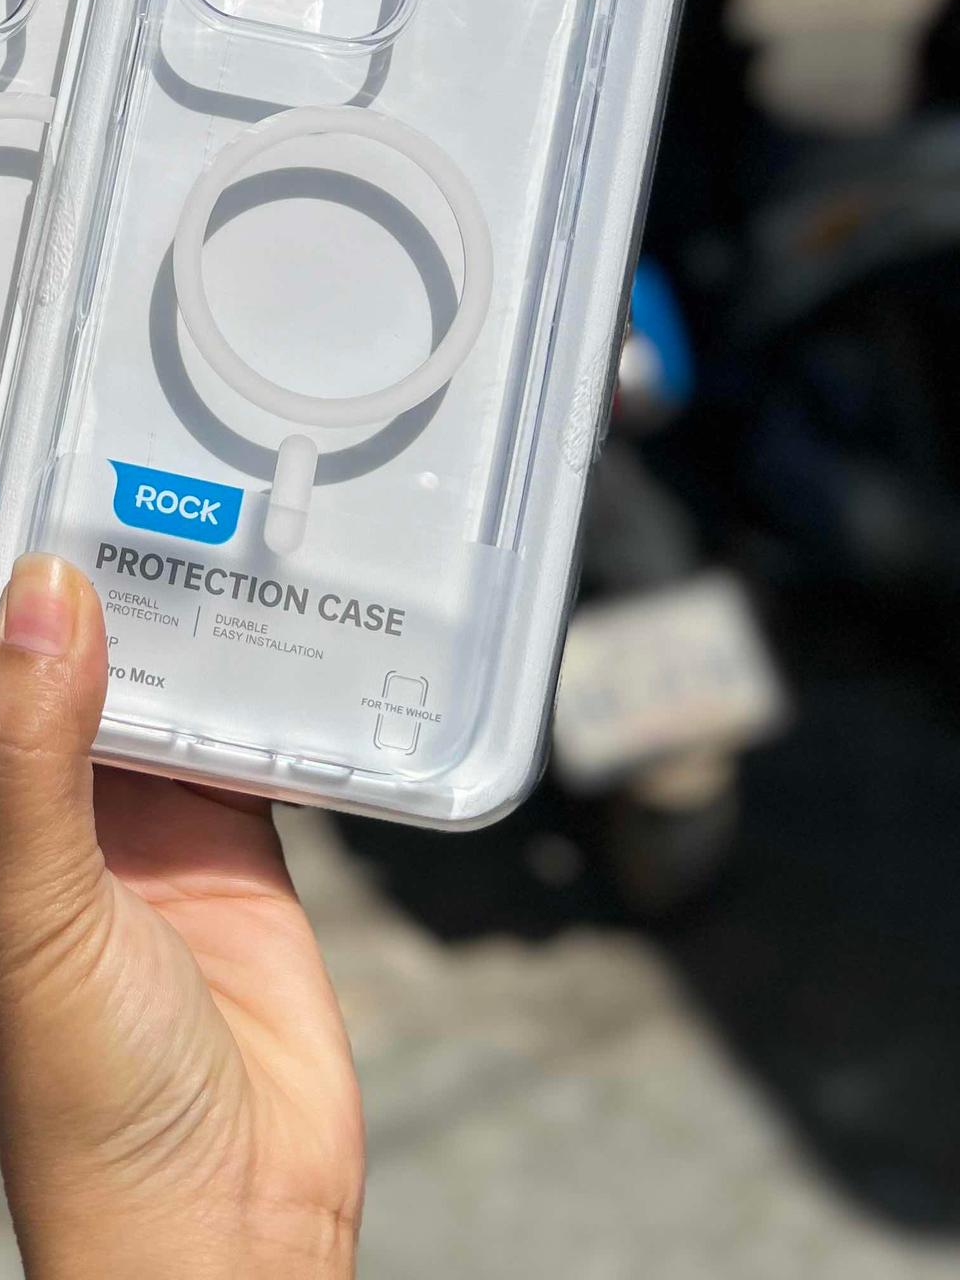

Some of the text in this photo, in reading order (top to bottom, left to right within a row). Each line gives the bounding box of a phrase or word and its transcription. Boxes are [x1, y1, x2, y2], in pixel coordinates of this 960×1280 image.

[135, 484, 221, 525] ROCK
[96, 542, 406, 637] PROTECTION CASE
[108, 589, 160, 610] OVERALL
[106, 602, 179, 627] PROTECTION
[215, 613, 269, 635] DURABLE
[213, 626, 324, 660] EASY INSTALLATION
[106, 663, 166, 689] ro Max
[360, 697, 442, 723] FOR THE WHOLE
